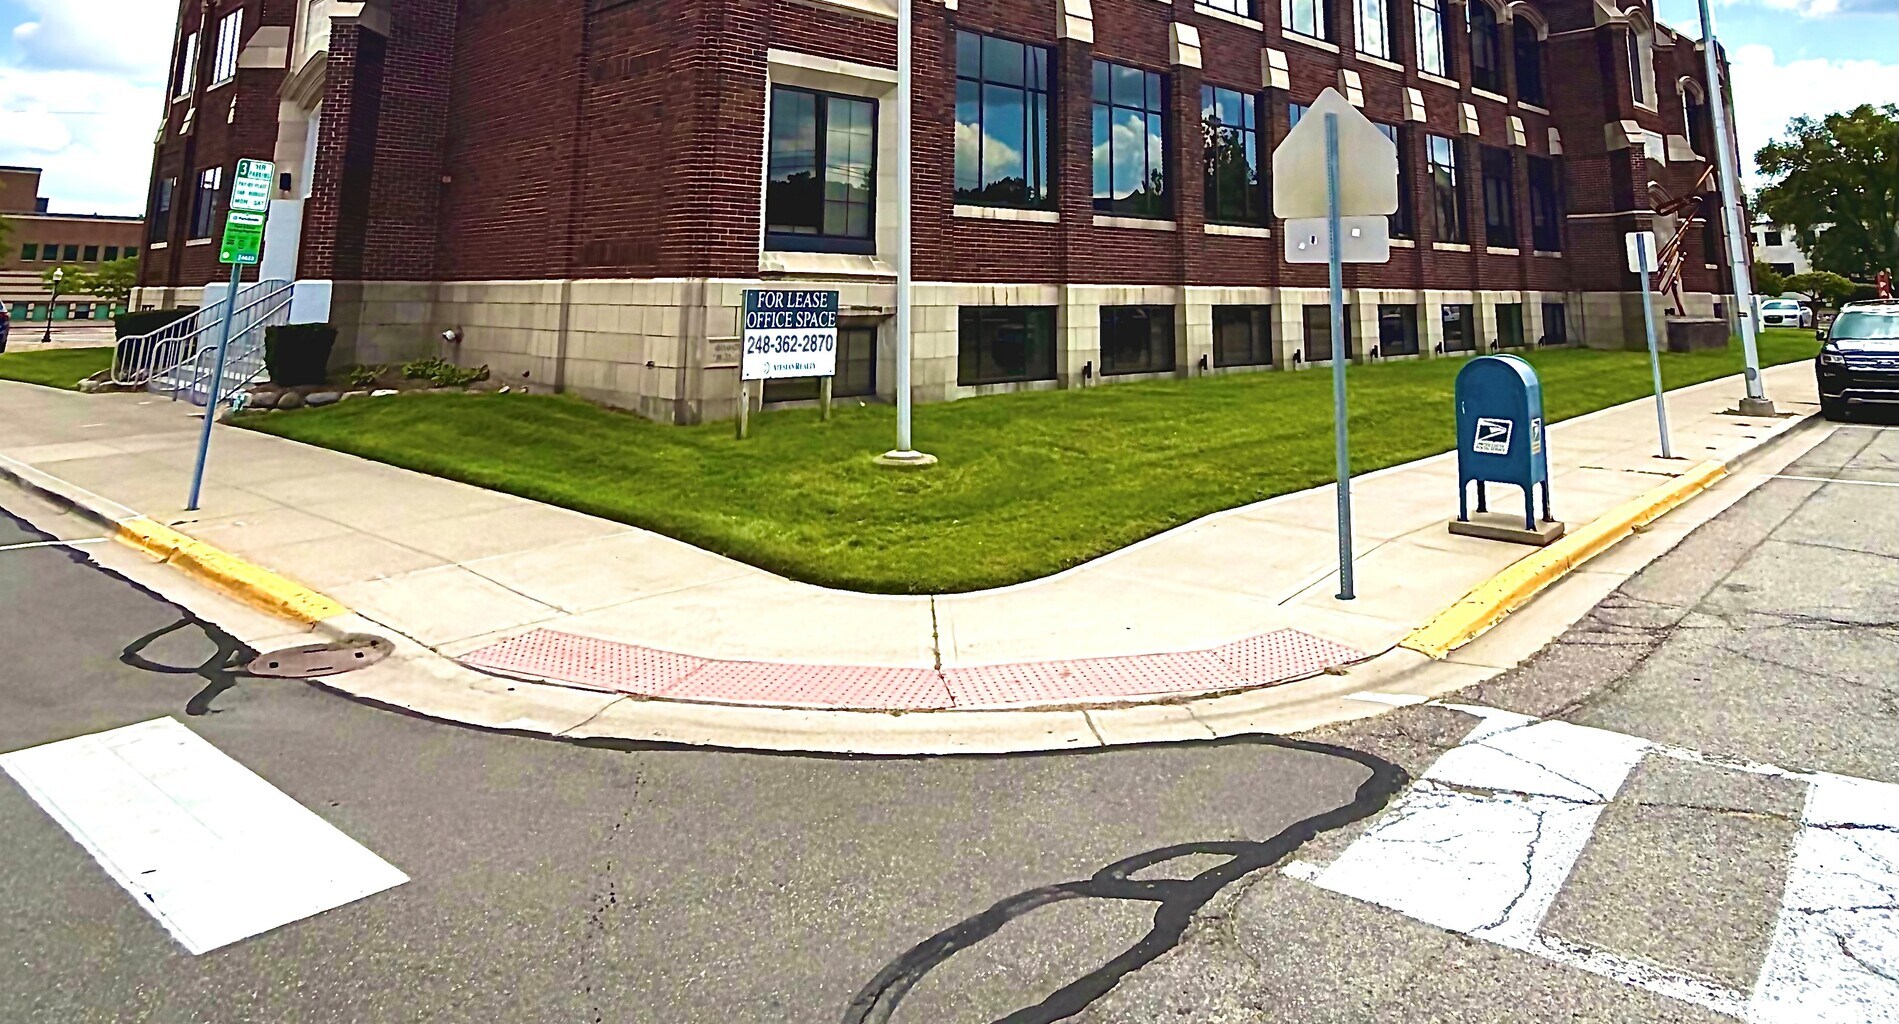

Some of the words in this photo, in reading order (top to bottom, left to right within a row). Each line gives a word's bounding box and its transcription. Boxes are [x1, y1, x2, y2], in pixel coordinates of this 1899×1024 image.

[240, 162, 248, 175] 3
[757, 291, 784, 308] FOR
[786, 291, 828, 308] LEASE
[746, 311, 793, 328] OFFICE
[795, 310, 836, 327] SPACE
[747, 334, 834, 354] 248-362-2870
